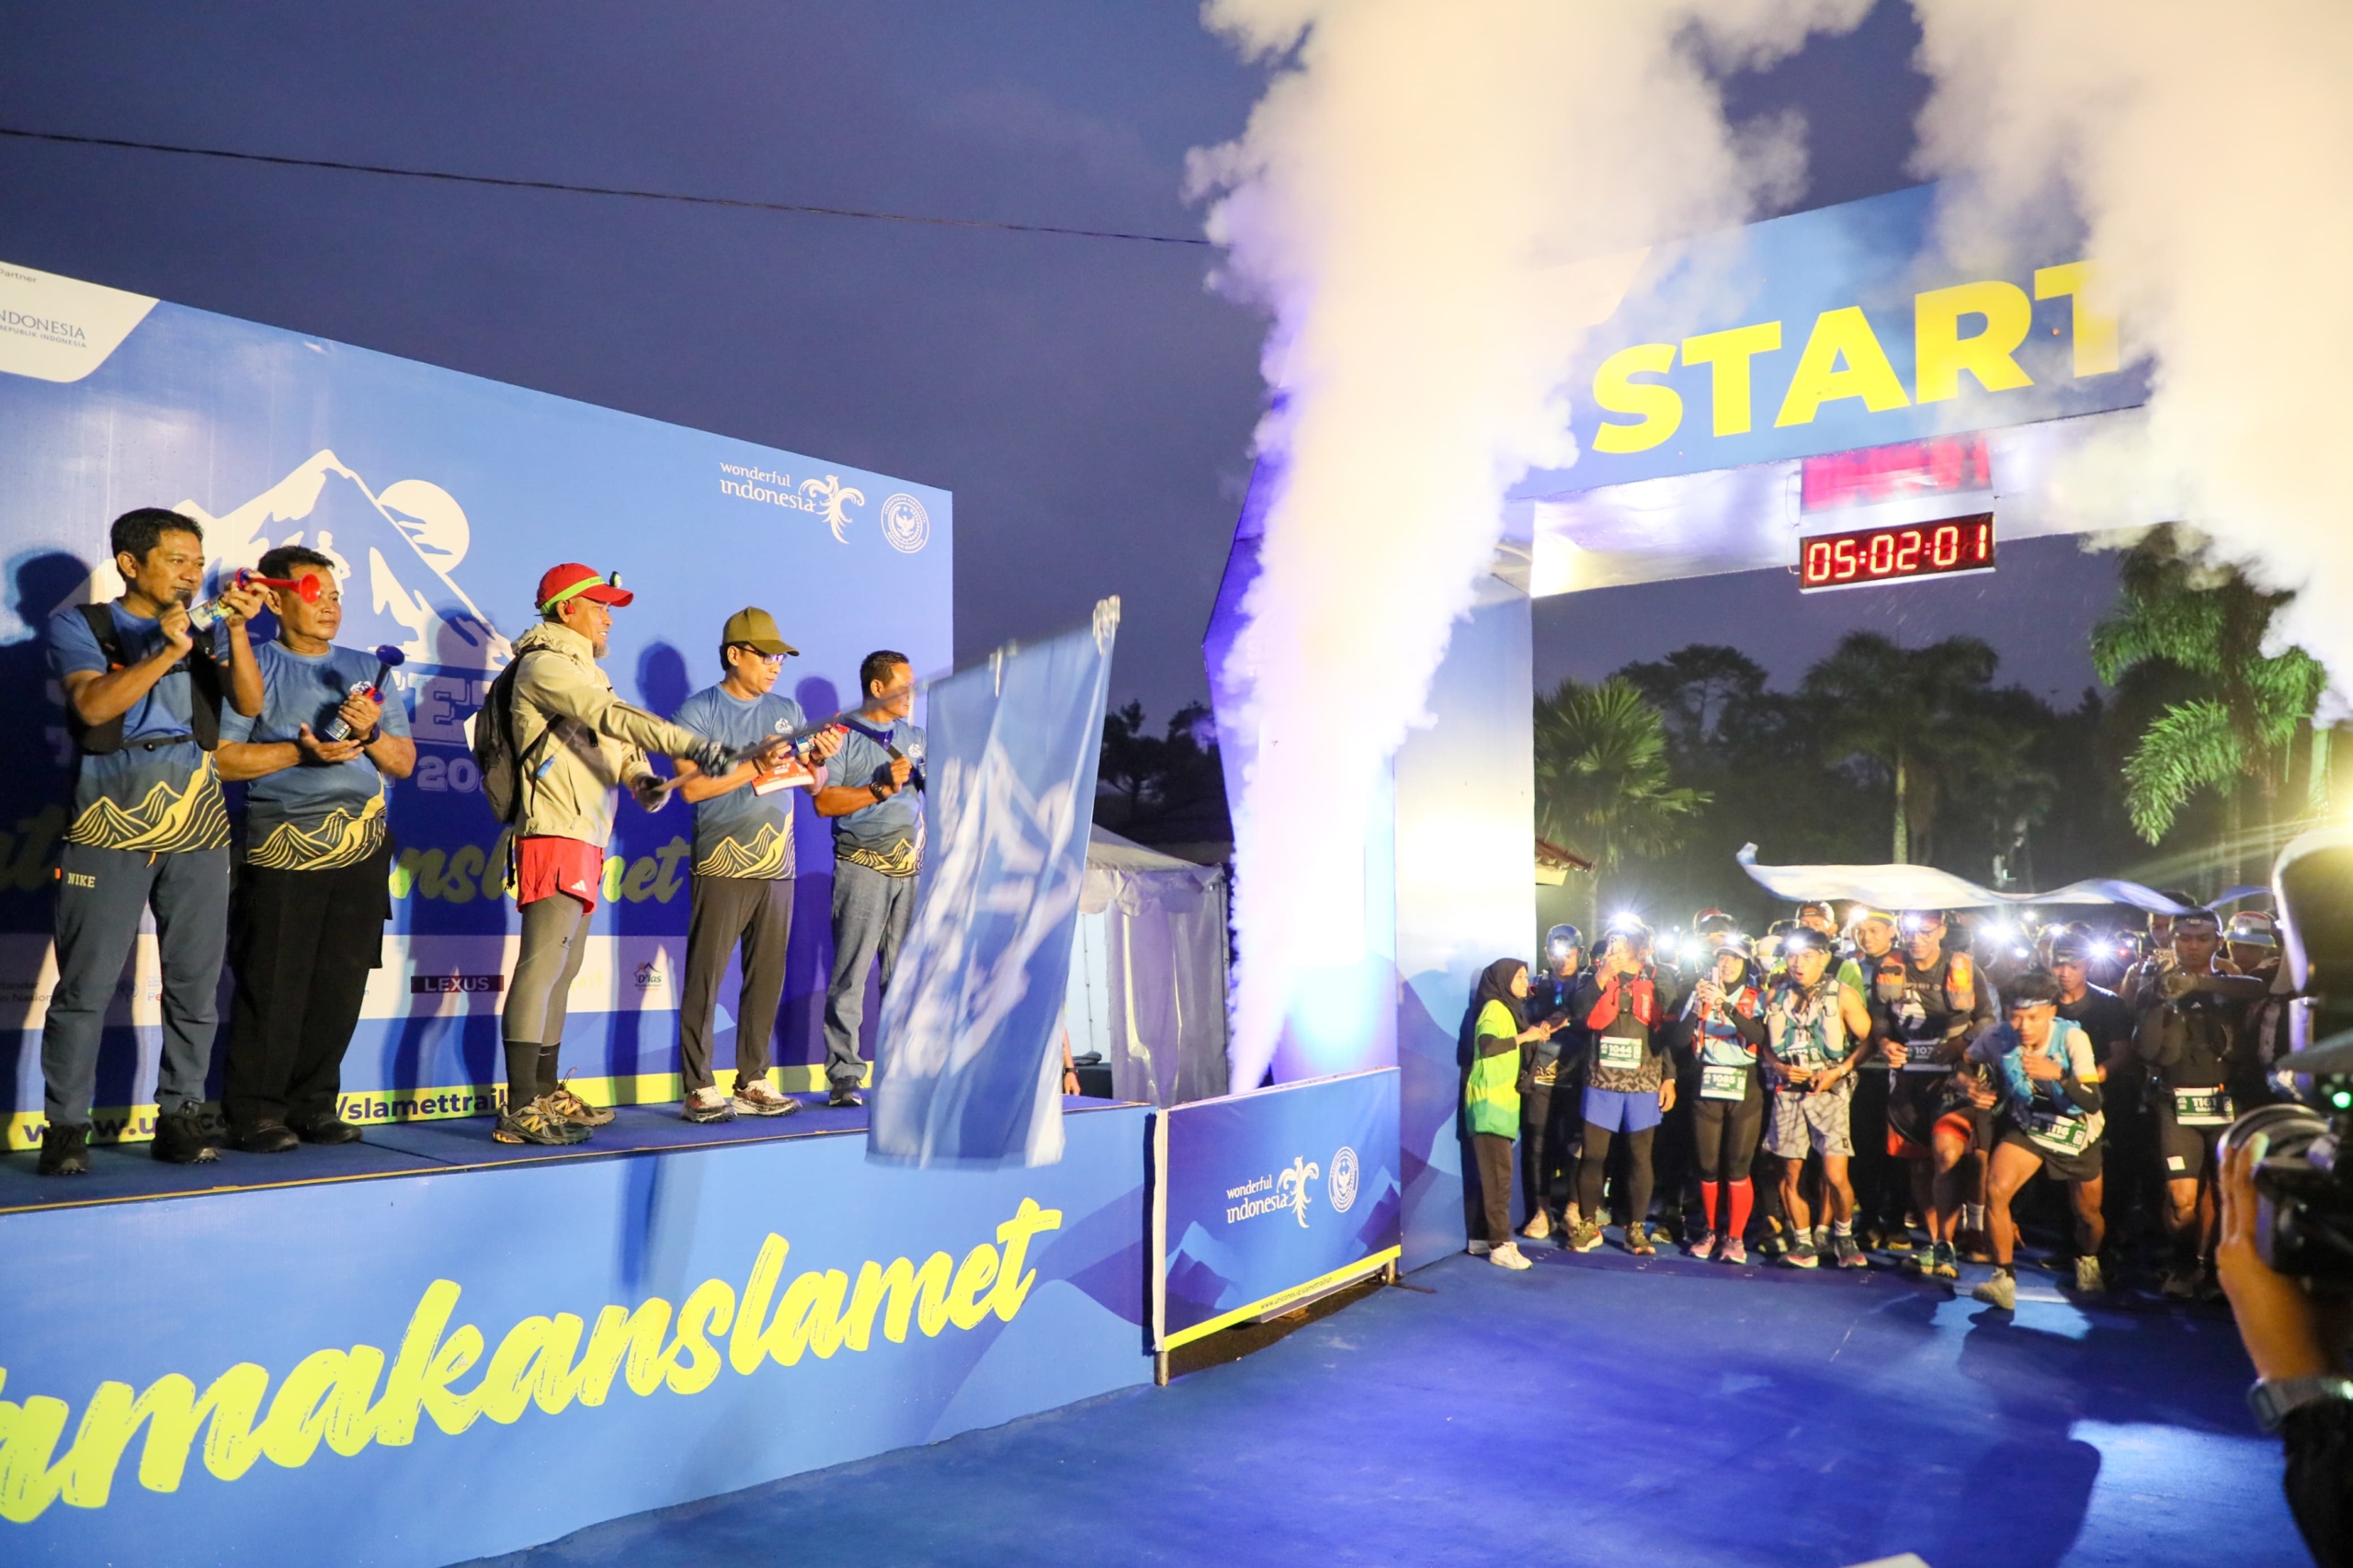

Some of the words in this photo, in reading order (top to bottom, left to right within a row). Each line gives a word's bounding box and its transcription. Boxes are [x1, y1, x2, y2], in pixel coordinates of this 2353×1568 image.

[40, 333, 86, 348] INDONESIA
[1592, 259, 2120, 453] START
[720, 461, 791, 487] wonderful
[720, 479, 815, 513] indonesia
[1808, 525, 1987, 581] 05:02:01
[67, 872, 96, 888] NIKE
[425, 977, 490, 992] LEXUS
[1226, 1174, 1272, 1199] wonderful
[1226, 1193, 1289, 1223] indonesia
